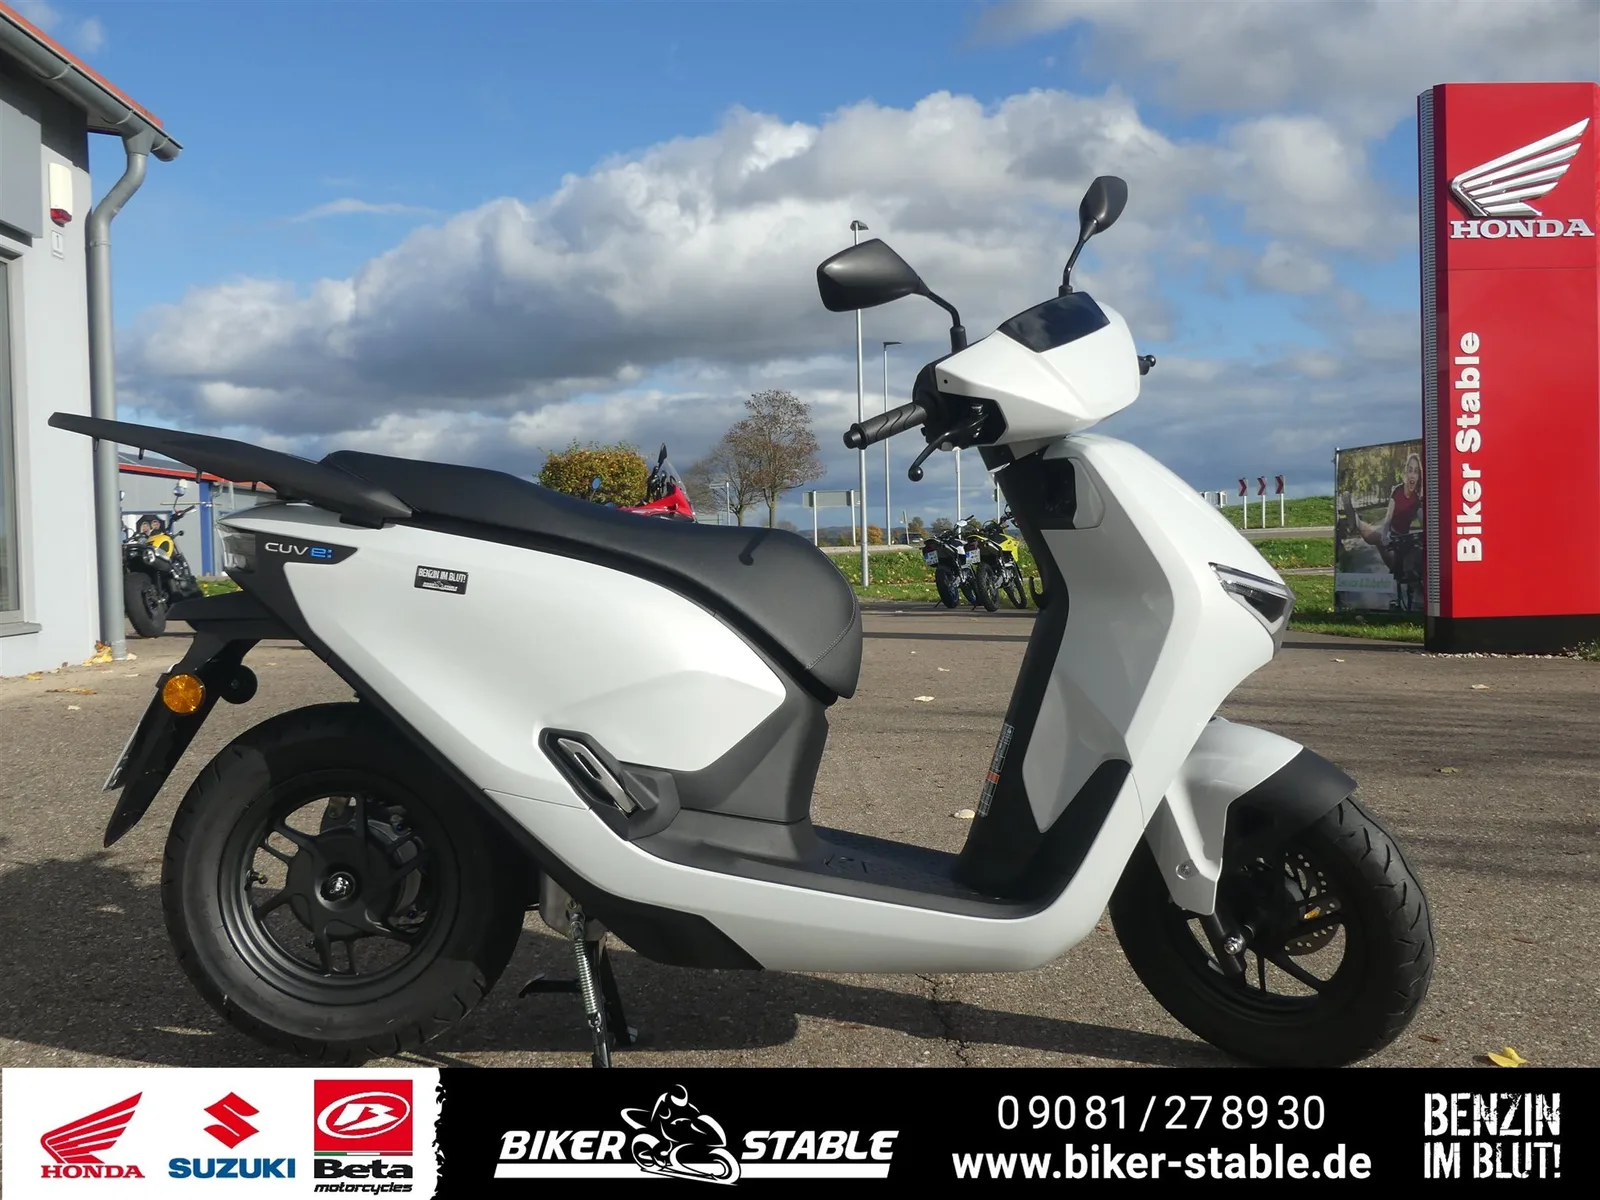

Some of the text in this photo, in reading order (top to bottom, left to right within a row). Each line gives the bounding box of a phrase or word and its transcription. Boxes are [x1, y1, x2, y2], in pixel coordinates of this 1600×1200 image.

[1450, 219, 1595, 239] HONDA
[1454, 331, 1482, 562] Biker Stable
